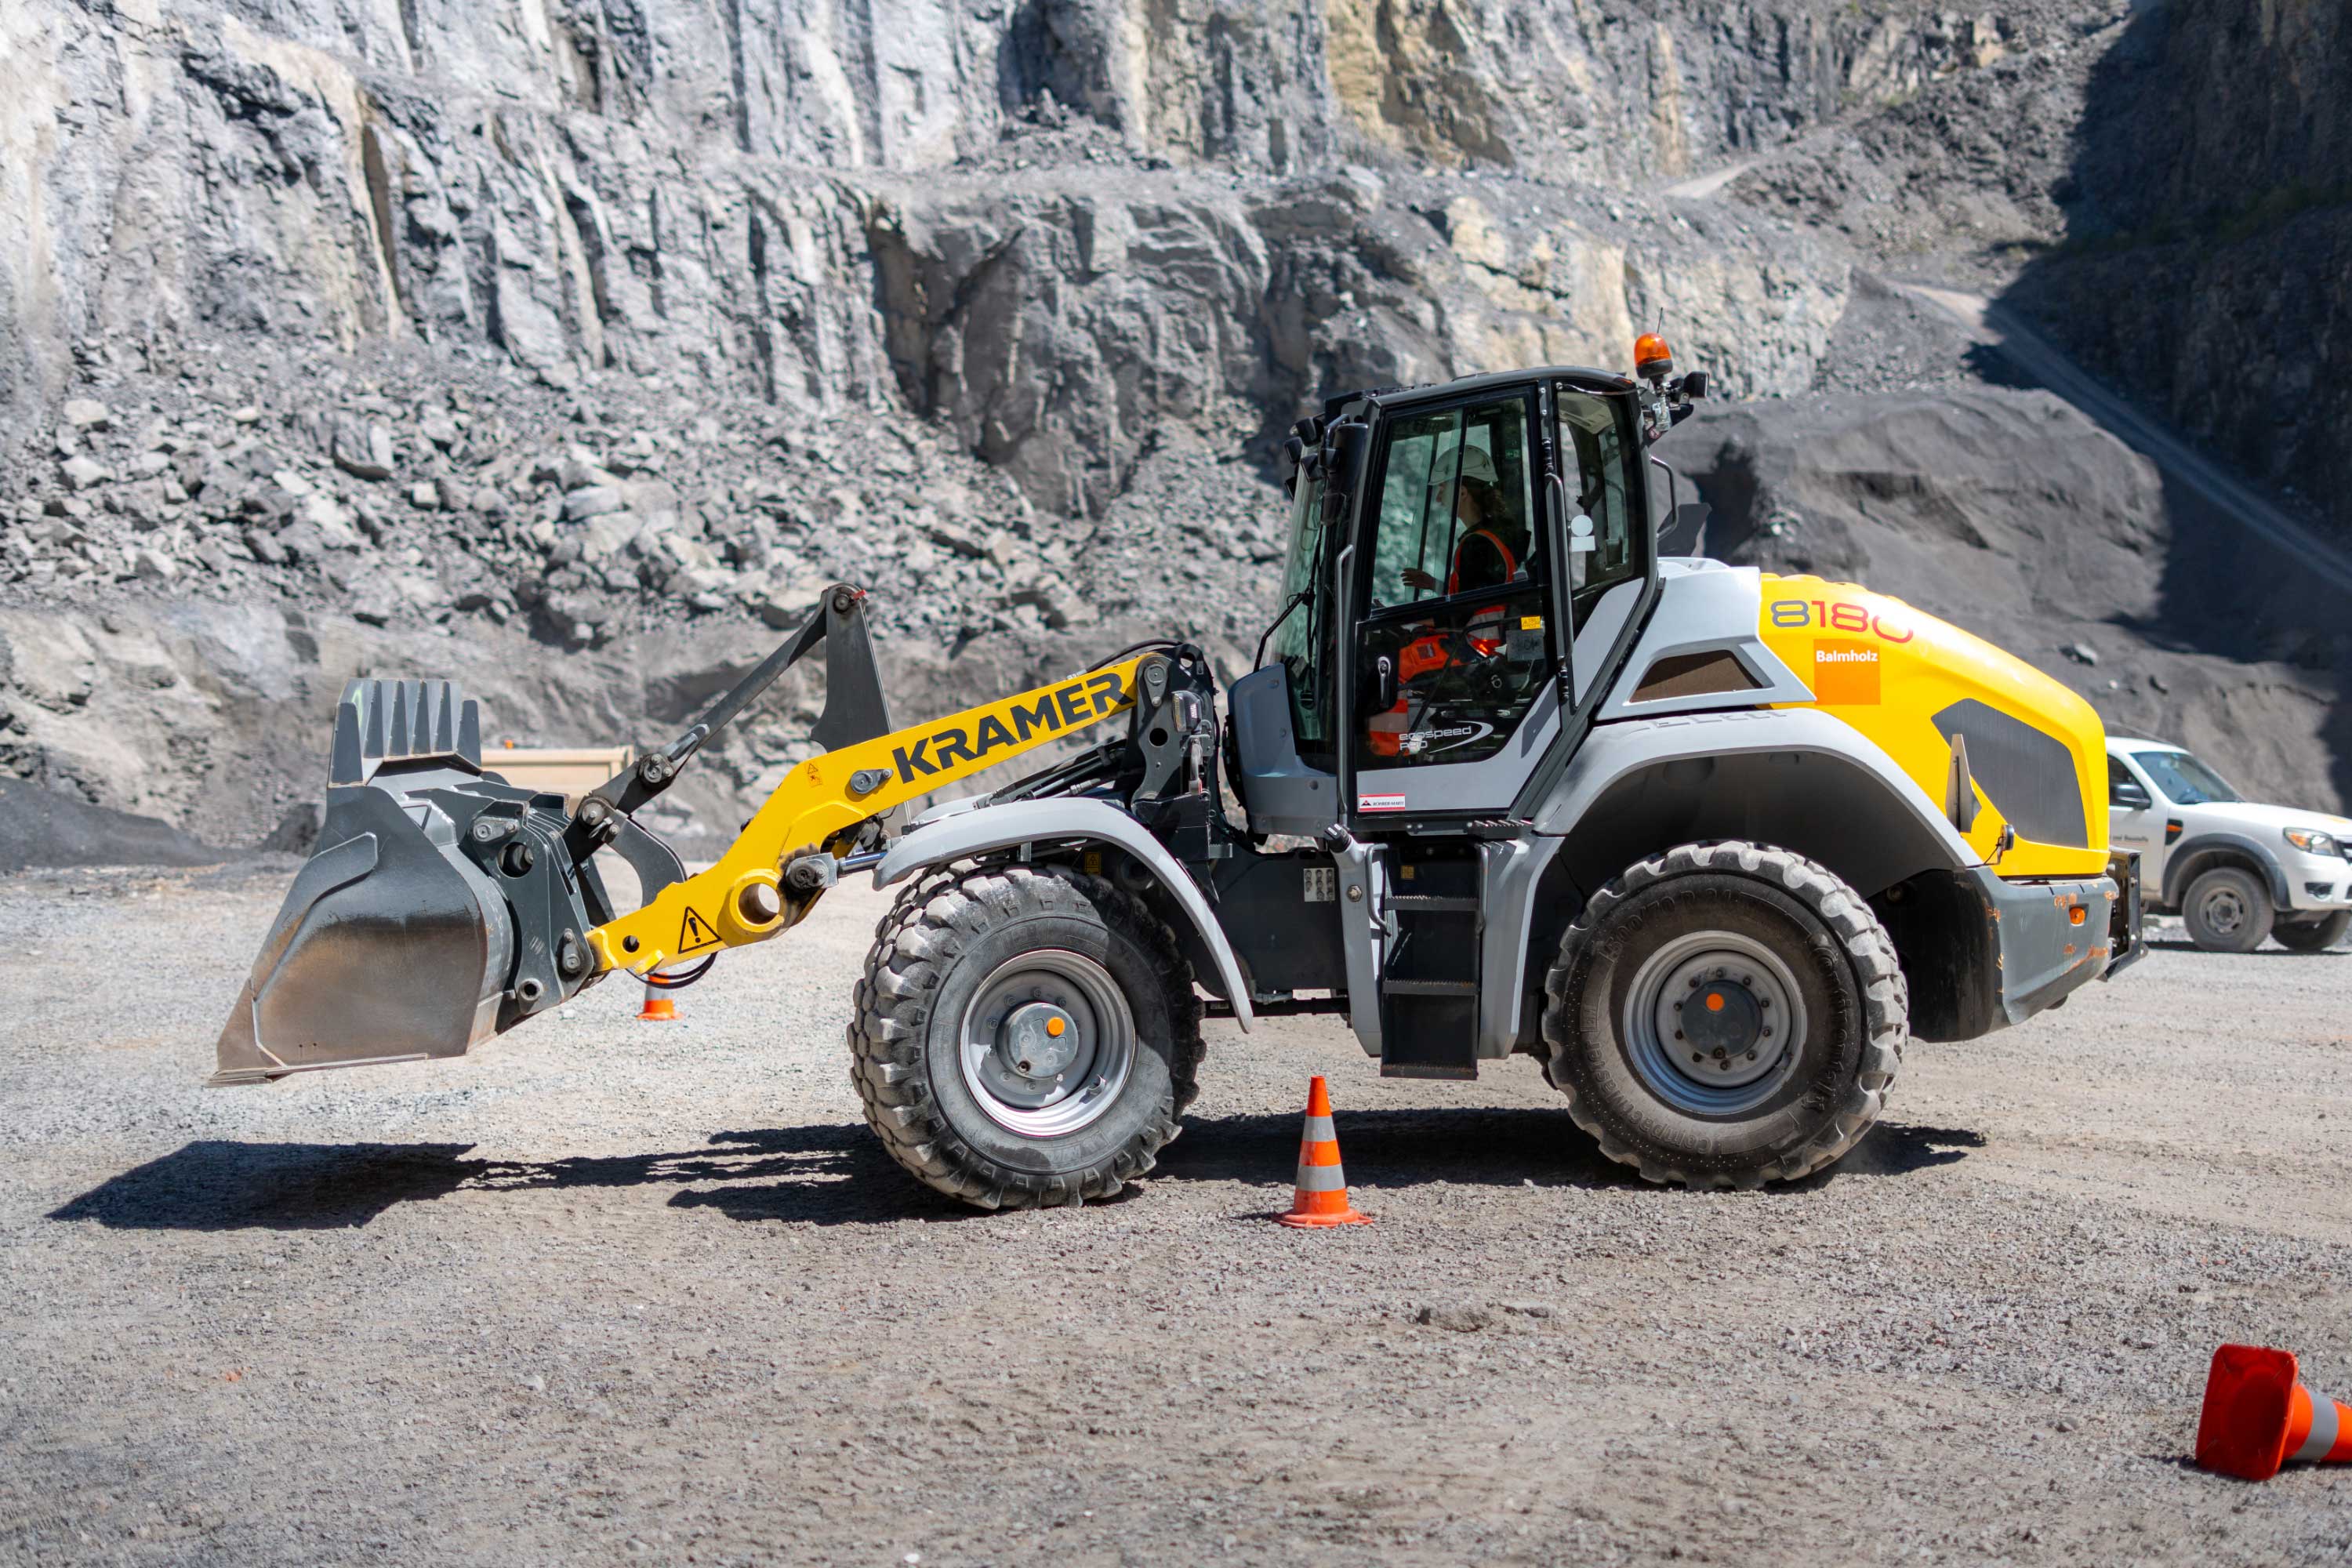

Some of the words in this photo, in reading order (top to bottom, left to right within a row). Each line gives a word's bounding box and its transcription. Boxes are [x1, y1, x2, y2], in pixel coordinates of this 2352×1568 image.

[1770, 600, 1914, 644] 8180
[1816, 649, 1878, 663] Balmholz
[891, 673, 1134, 784] KRAMER
[1399, 725, 1472, 741] ecospeed
